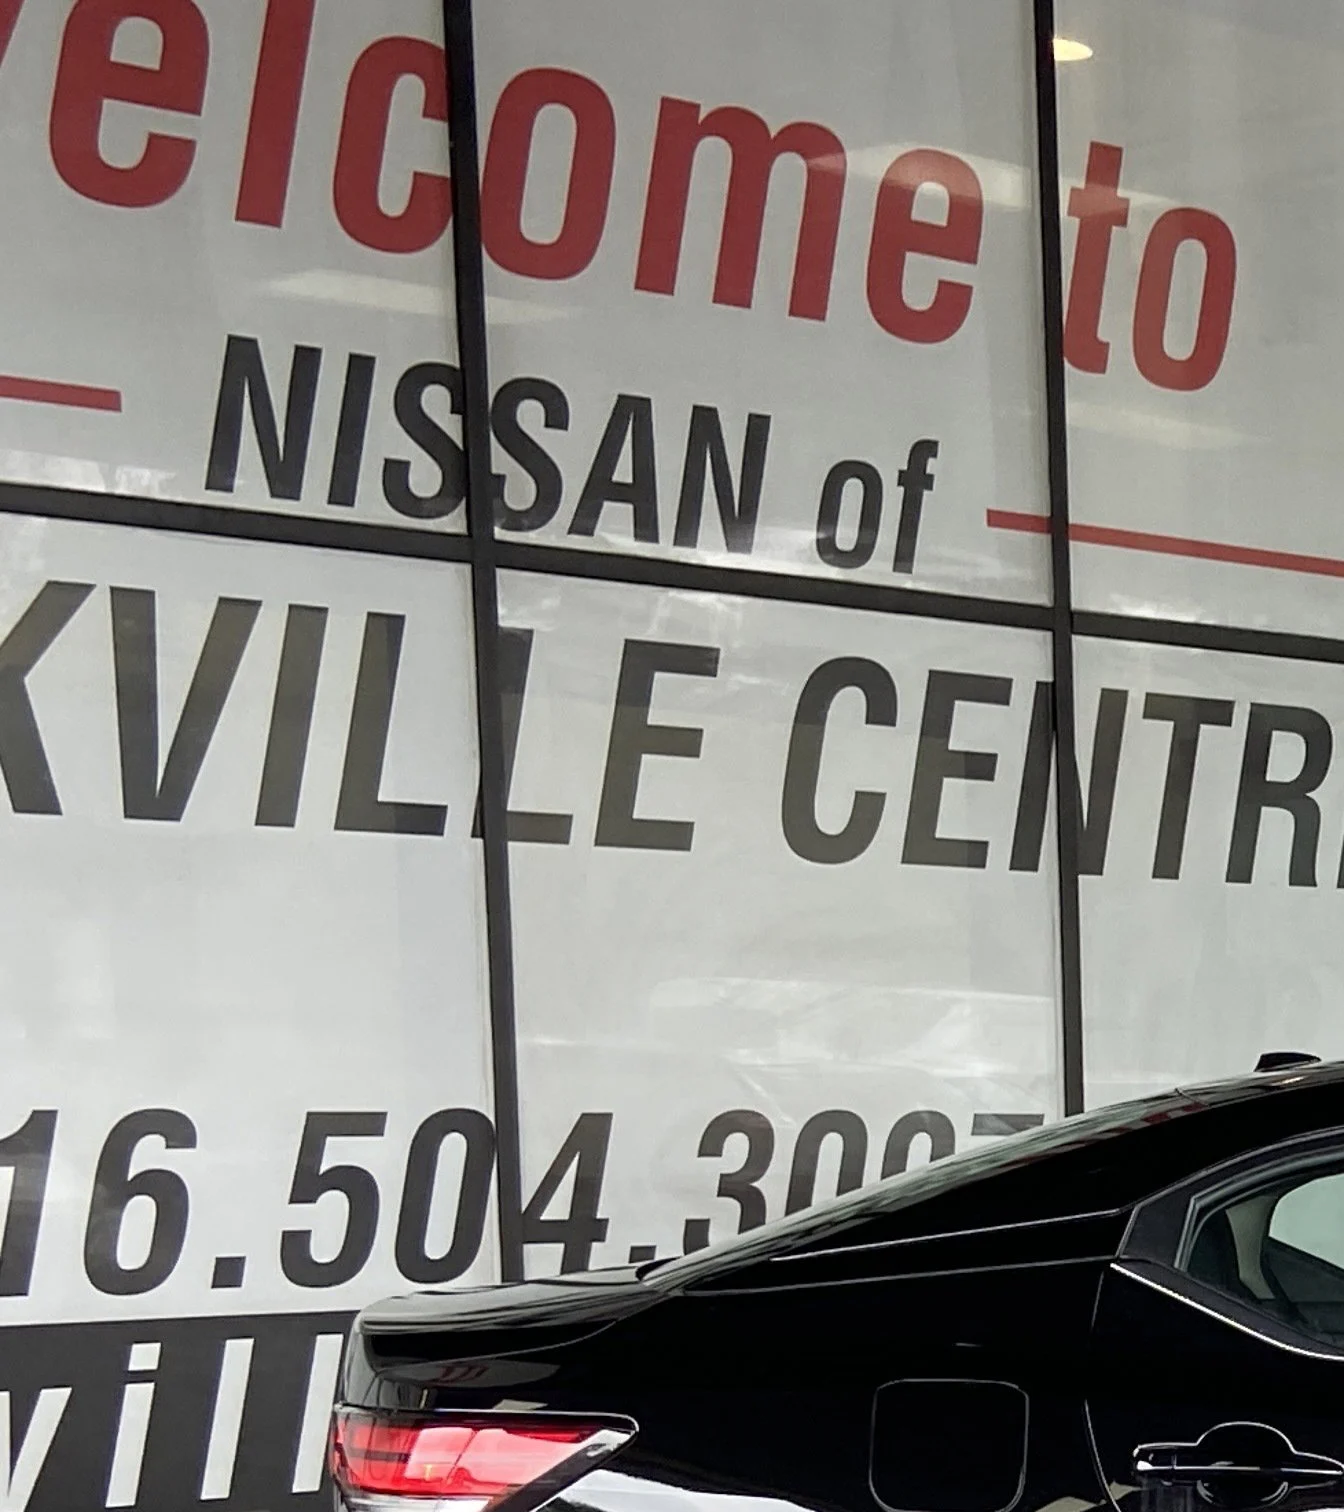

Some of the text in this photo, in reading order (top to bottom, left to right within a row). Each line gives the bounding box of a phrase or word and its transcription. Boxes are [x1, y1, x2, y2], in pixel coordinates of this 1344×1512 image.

[0, 0, 1238, 392] elcome to
[205, 334, 940, 575] NISSAN of
